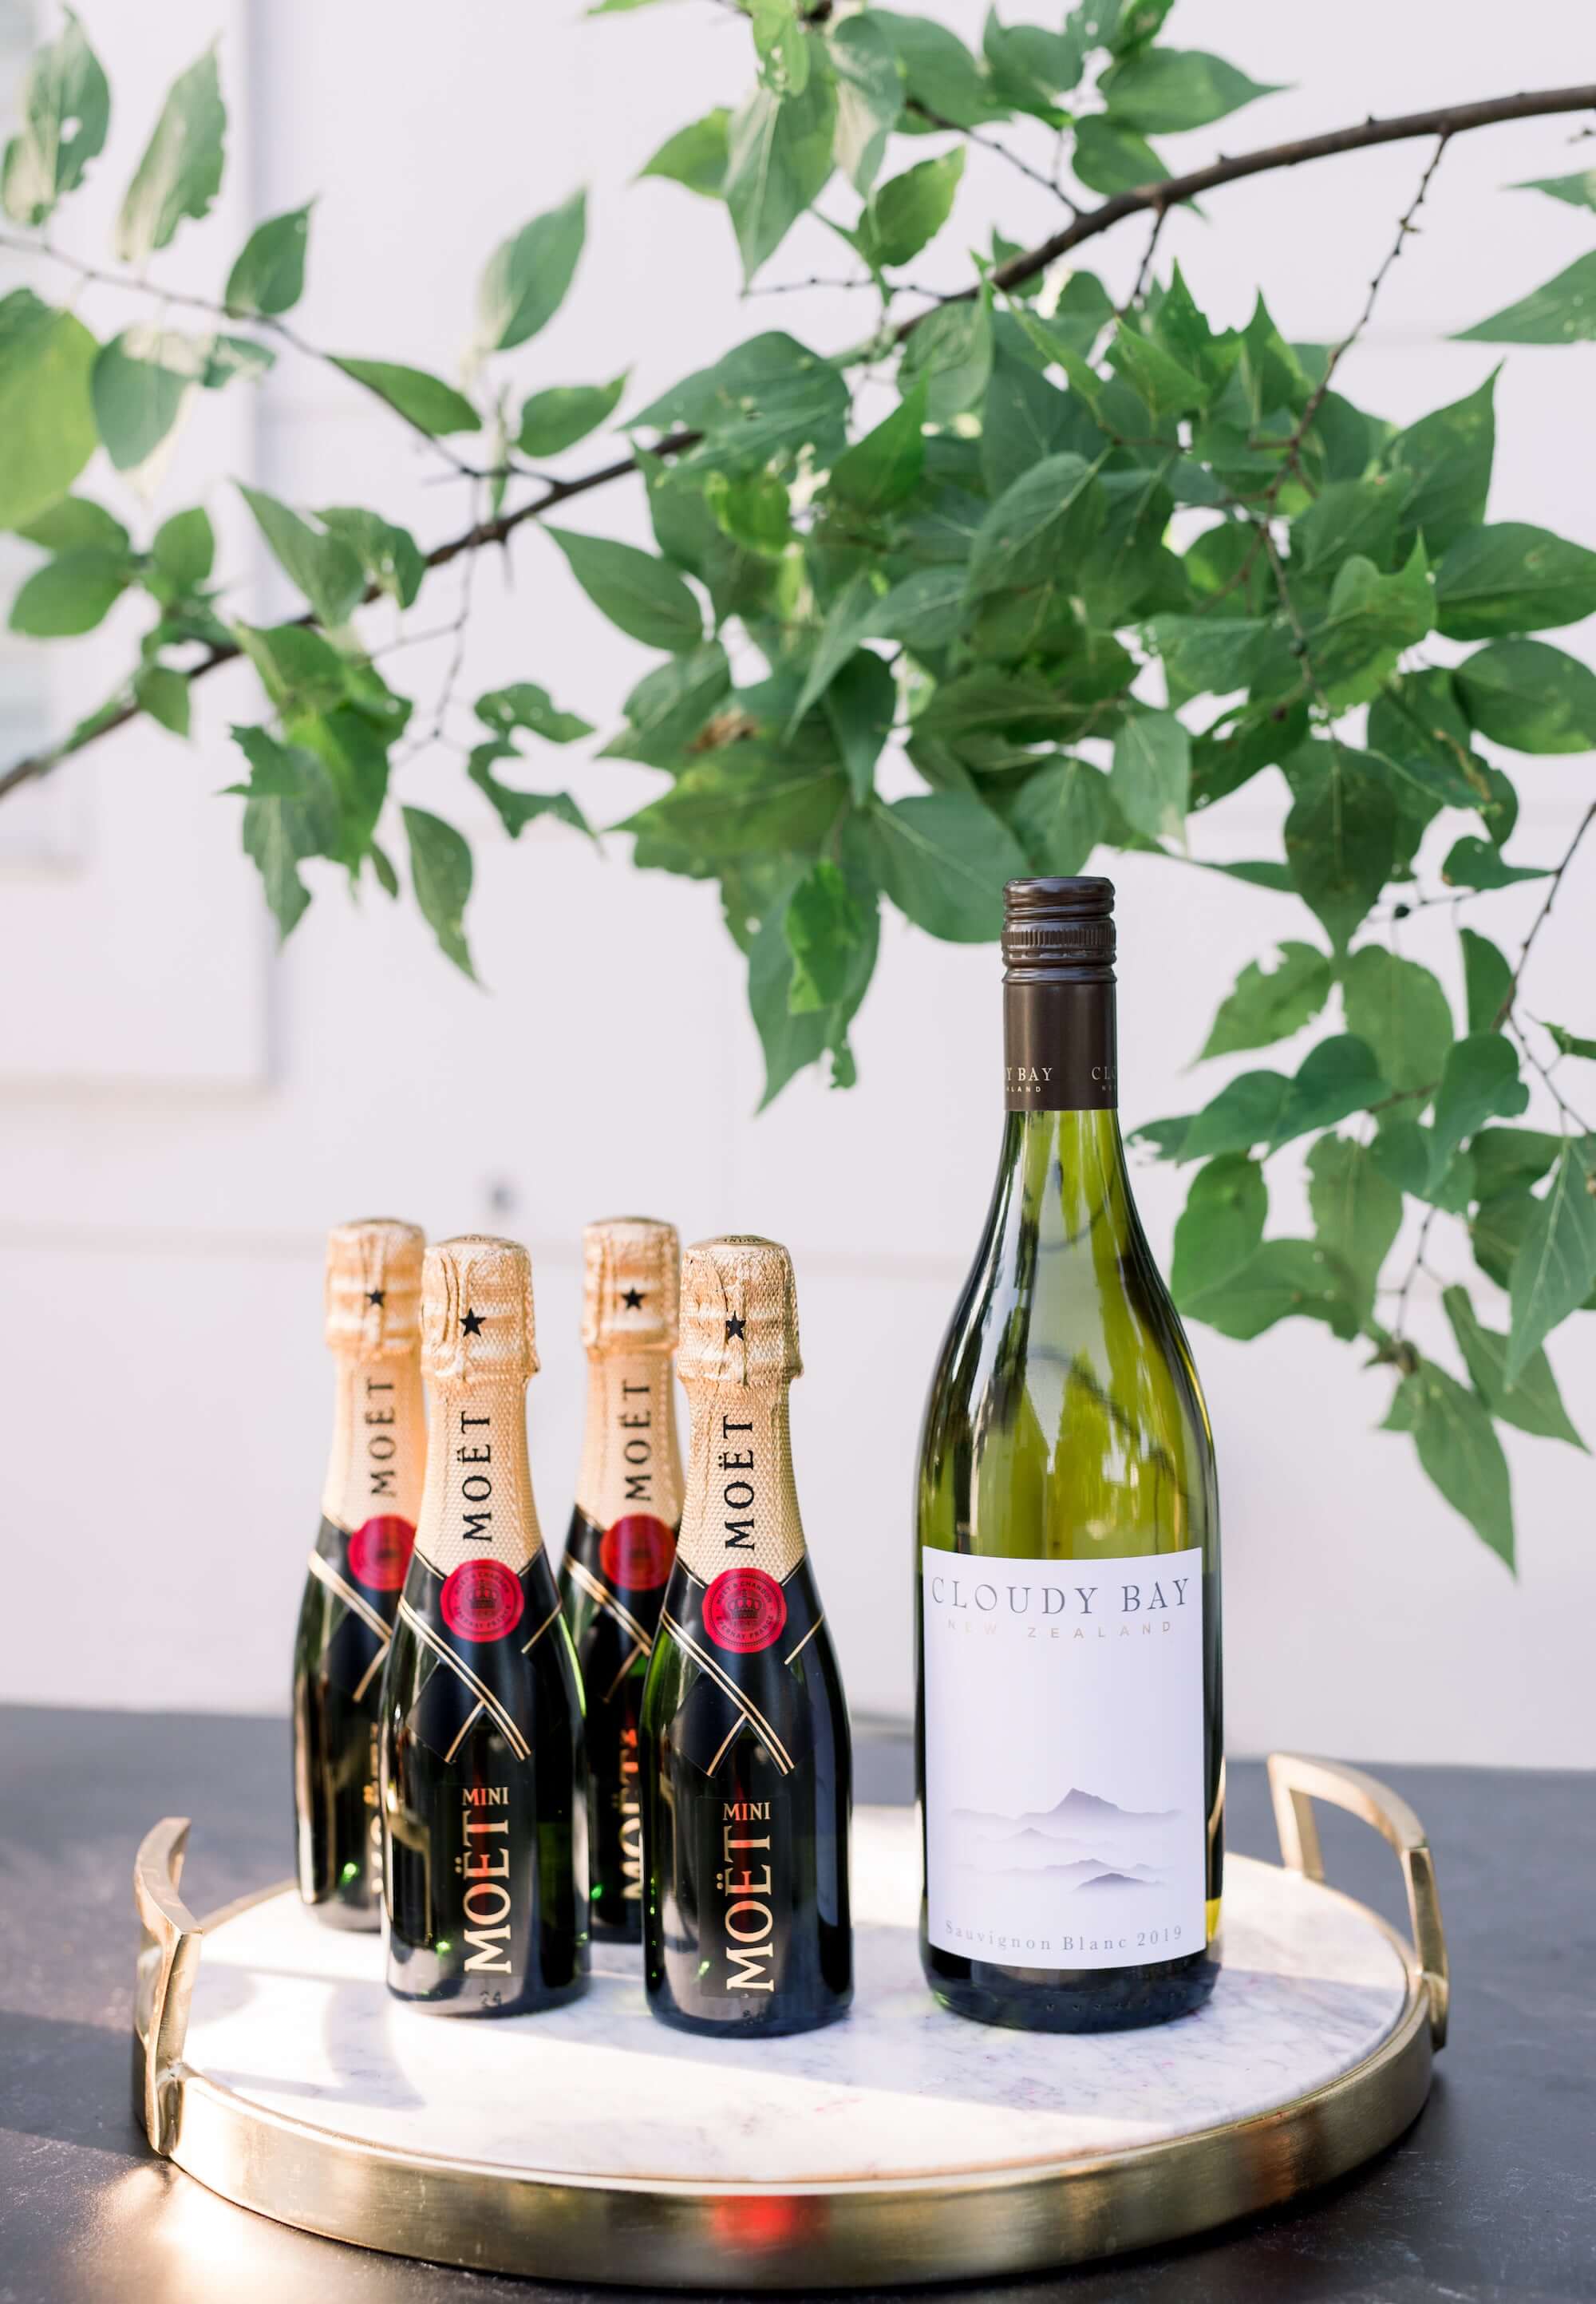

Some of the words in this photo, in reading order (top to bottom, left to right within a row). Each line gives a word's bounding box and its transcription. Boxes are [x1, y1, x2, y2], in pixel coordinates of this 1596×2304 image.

[1017, 1067, 1053, 1081] BAY
[456, 1410, 492, 1542] MOËT
[718, 1414, 755, 1551] MOËT
[931, 1576, 1098, 1614] CLOUDY
[1121, 1578, 1190, 1613] BAY
[947, 1618, 997, 1636] NEW
[1027, 1621, 1171, 1639] ZEALAND
[462, 1787, 510, 1806] MINI
[722, 1802, 771, 1821] MINI
[454, 1809, 512, 1974] MOËT
[716, 1824, 775, 1993] MOËT
[945, 1919, 1052, 1950] Sauvignon
[1062, 1935, 1128, 1951] Blanc
[1136, 1926, 1182, 1946] 2019
